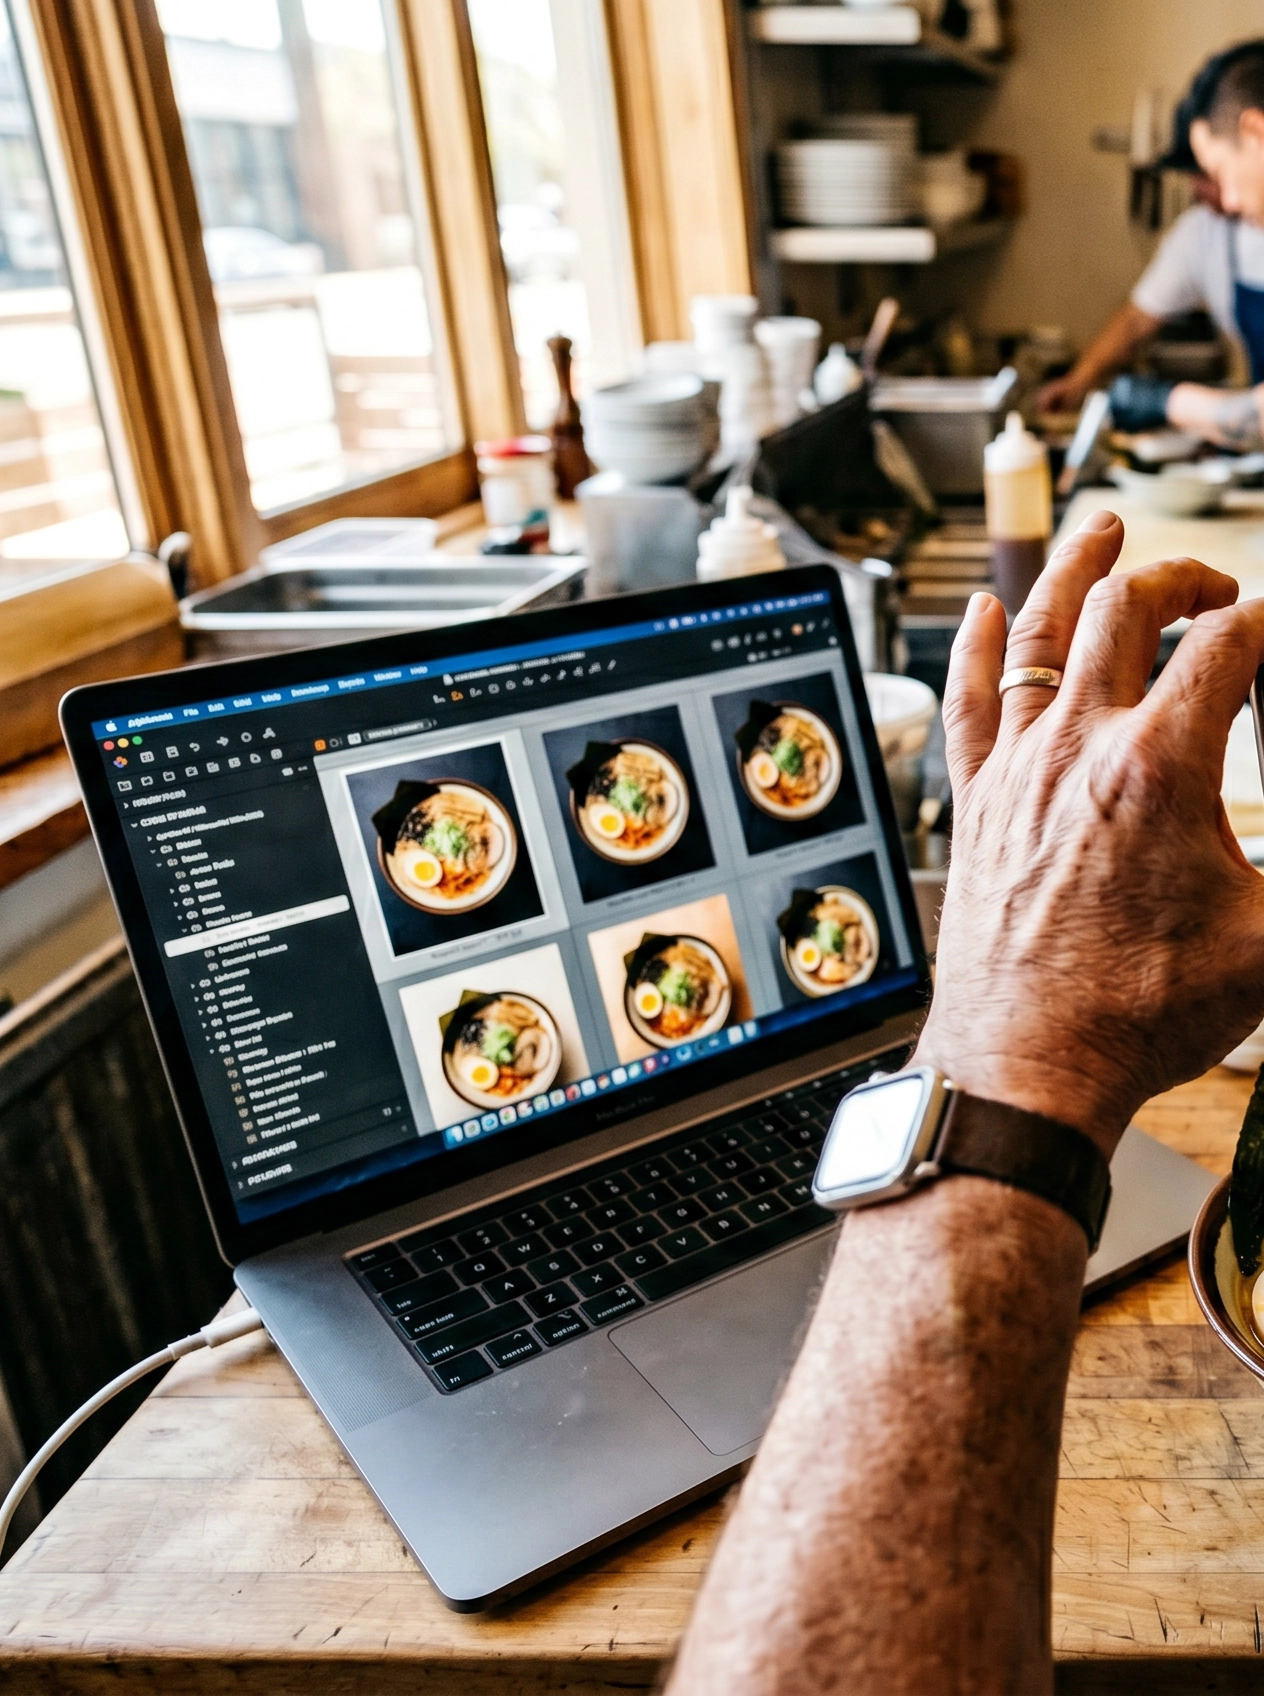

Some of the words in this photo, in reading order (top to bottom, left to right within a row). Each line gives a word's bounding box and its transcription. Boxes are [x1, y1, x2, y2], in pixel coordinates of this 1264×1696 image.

[473, 1263, 486, 1272] Q
[517, 1243, 531, 1253] W
[504, 1281, 515, 1291] A
[592, 1243, 604, 1252] D
[636, 1226, 644, 1234] F
[544, 1293, 556, 1303] Z
[591, 1273, 603, 1283] X
[635, 1255, 647, 1264] C
[676, 1237, 687, 1246] V
